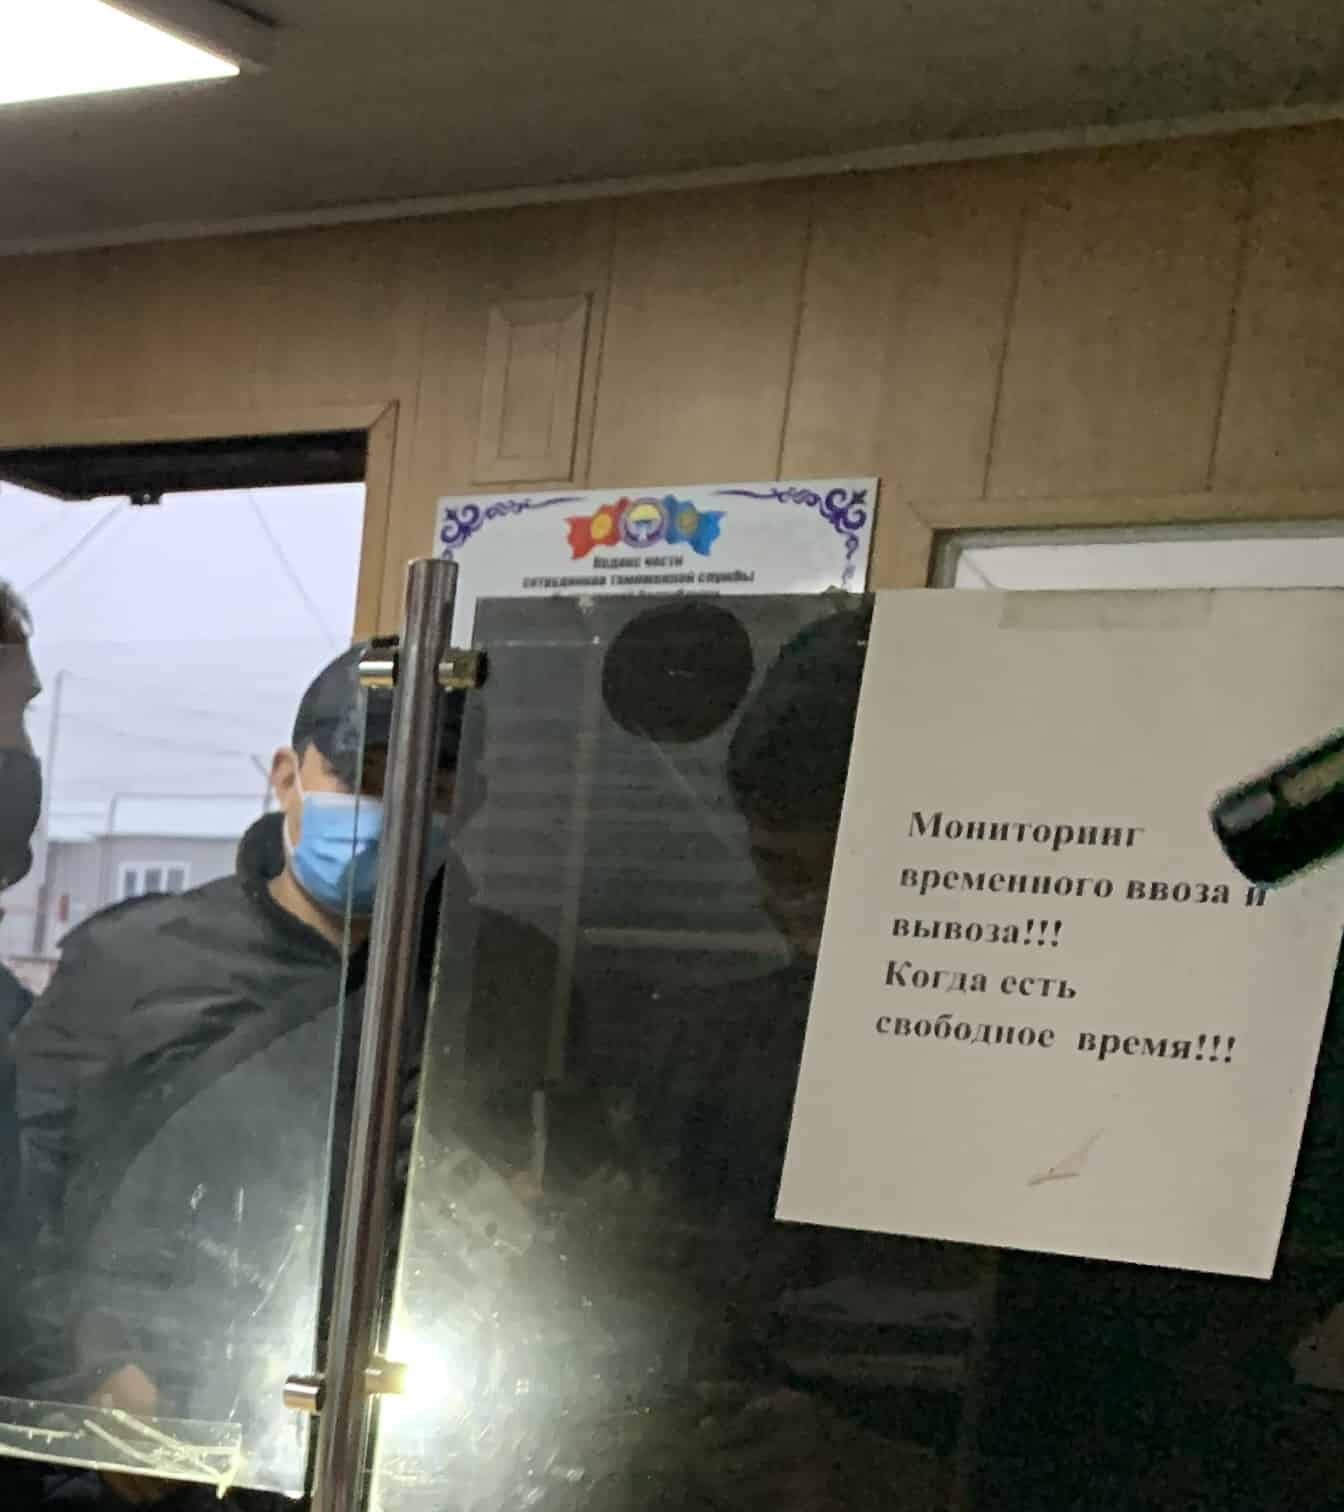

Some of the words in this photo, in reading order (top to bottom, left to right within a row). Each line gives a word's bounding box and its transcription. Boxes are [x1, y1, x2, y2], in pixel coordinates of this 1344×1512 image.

[908, 810, 1146, 852] Мониторинг
[898, 864, 1114, 899] временного
[1125, 878, 1230, 905] ввоза
[891, 917, 1064, 949] вывоза!!!
[884, 959, 987, 994] Когда
[1000, 973, 1078, 1001] есть
[875, 1012, 1055, 1049] свободное
[1076, 1027, 1237, 1064] время!!!
